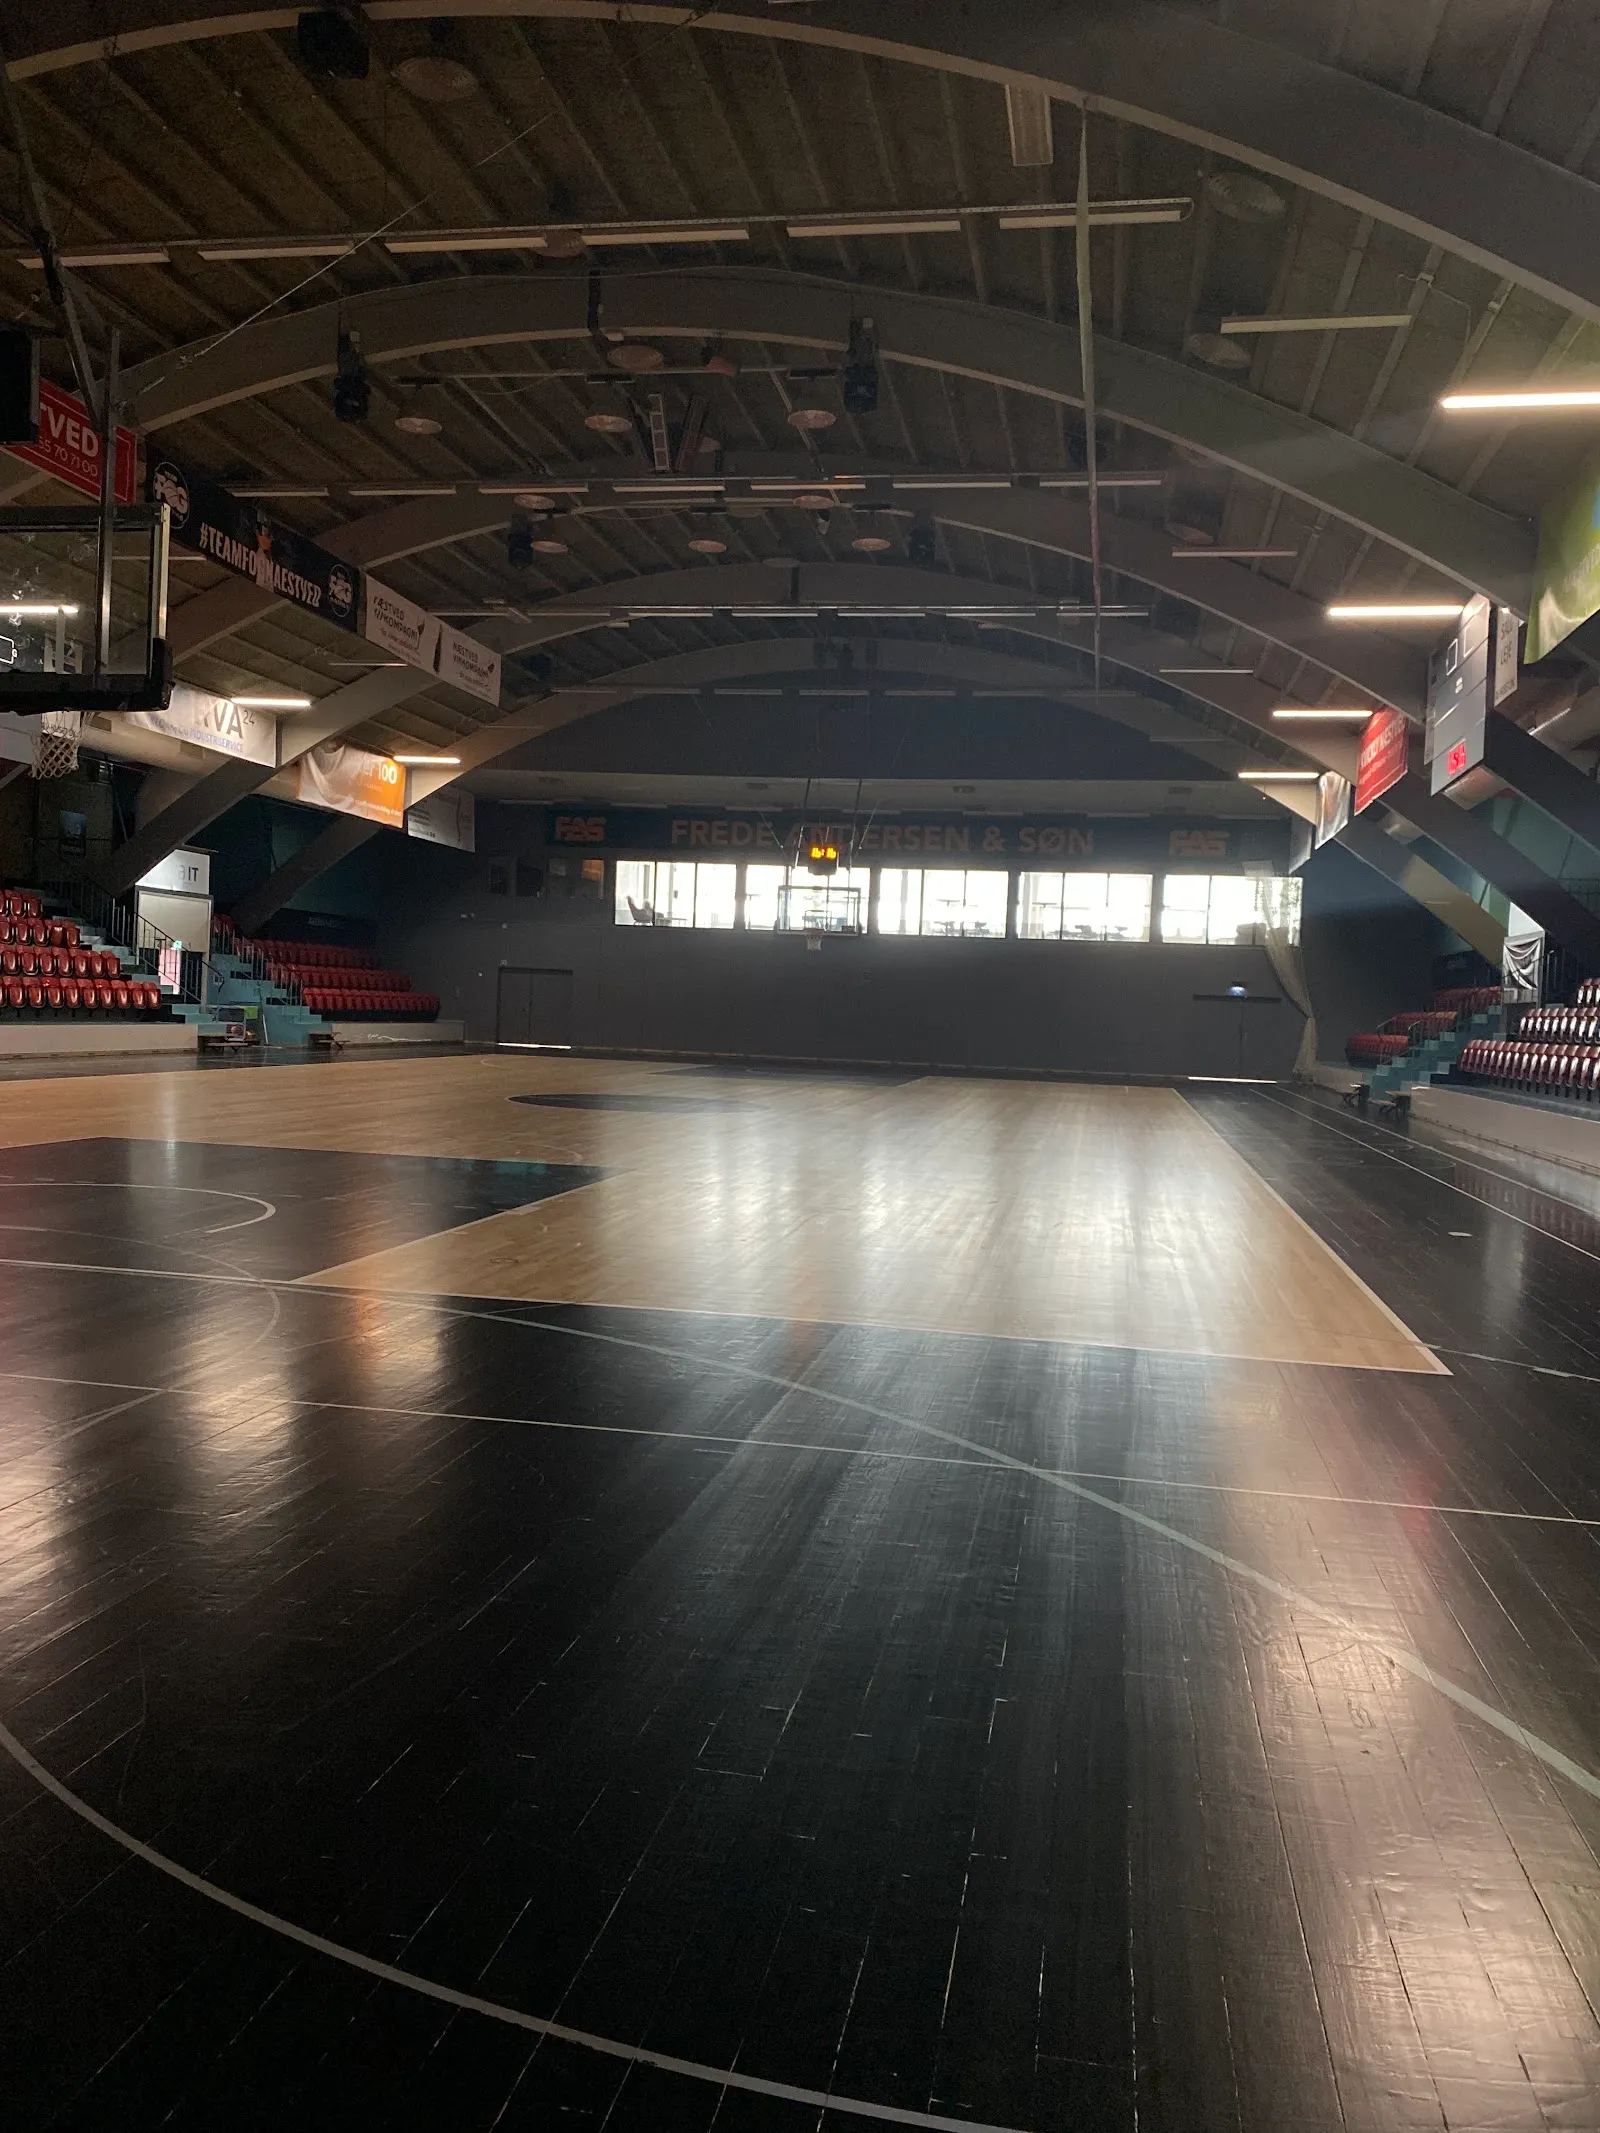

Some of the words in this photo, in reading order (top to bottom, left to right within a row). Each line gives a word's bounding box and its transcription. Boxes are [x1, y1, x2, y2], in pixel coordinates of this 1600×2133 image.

[54, 444, 69, 462] 70
[81, 460, 98, 477] 00
[242, 709, 256, 726] 24
[671, 819, 774, 847] FREDE
[981, 825, 1006, 853] &
[1018, 826, 1095, 855] SØN
